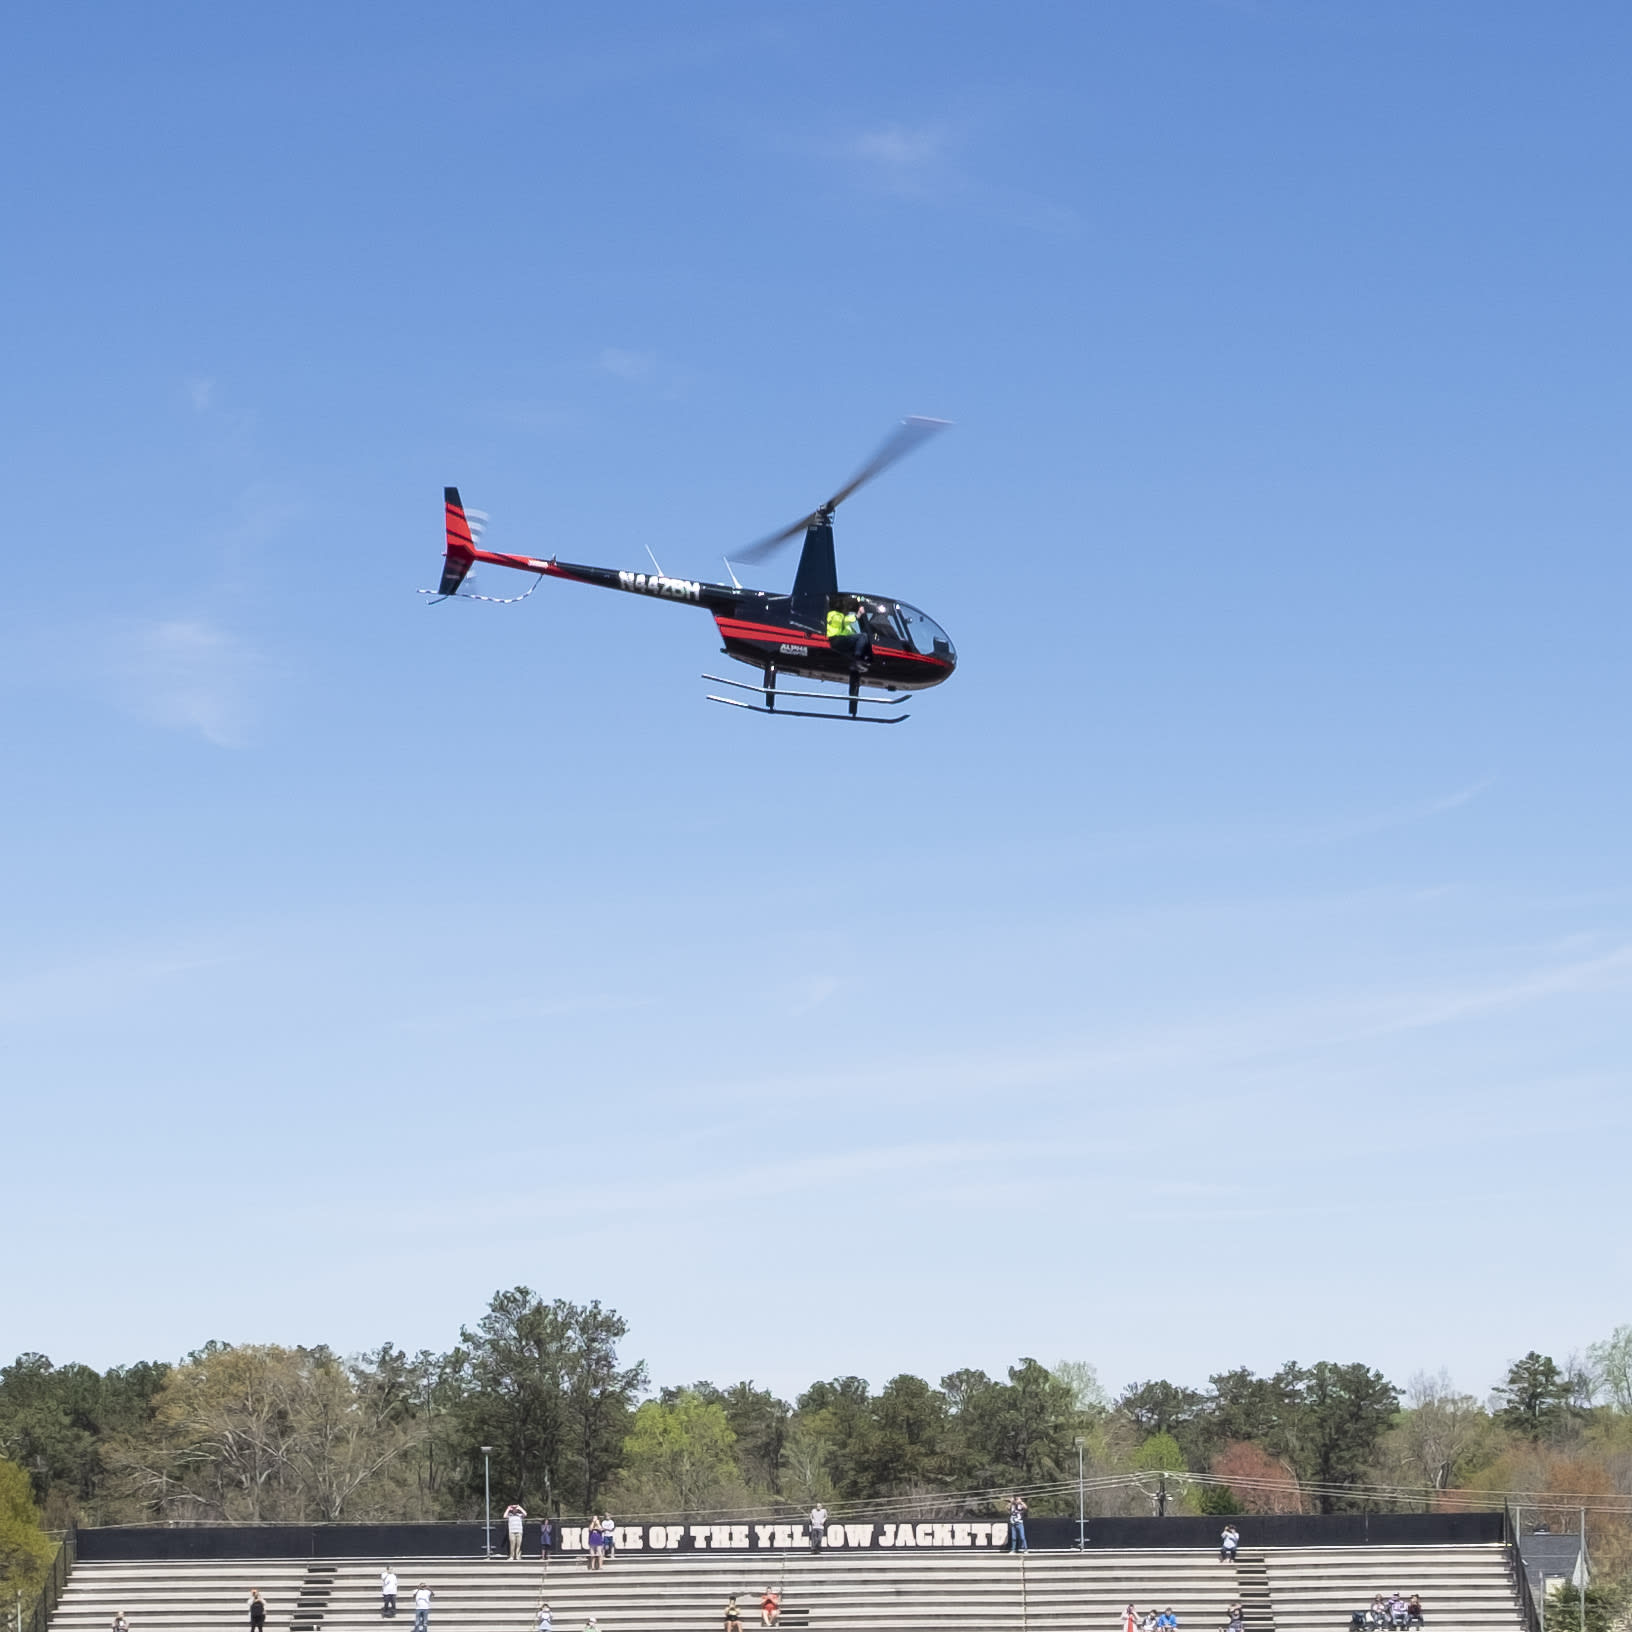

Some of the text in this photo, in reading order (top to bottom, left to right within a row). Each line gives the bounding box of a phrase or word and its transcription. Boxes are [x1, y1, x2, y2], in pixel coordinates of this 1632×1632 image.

[649, 1526, 685, 1549] OF
[690, 1525, 749, 1548] THE
[755, 1523, 874, 1548] YELOW
[879, 1523, 1008, 1547] JACKETS
